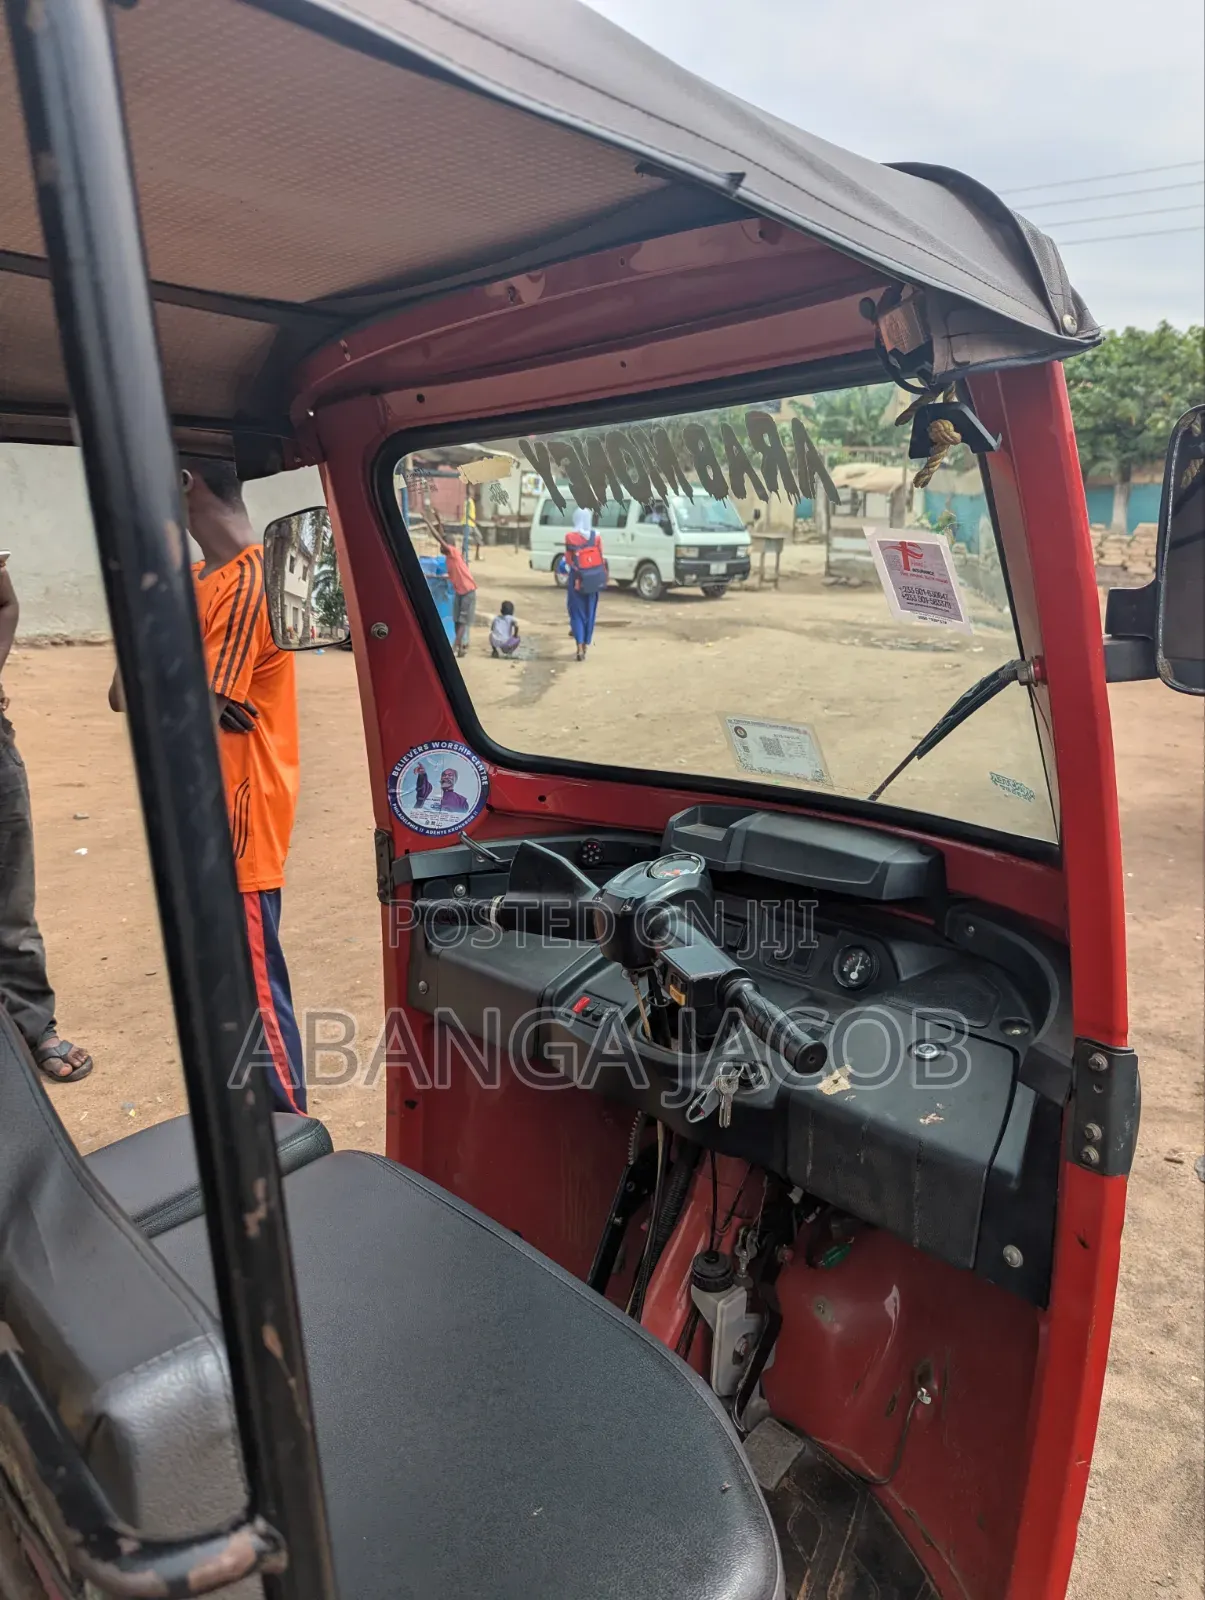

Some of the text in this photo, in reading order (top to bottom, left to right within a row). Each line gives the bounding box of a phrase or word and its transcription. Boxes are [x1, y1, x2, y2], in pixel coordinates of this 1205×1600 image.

[391, 741, 489, 786] BELIEVERS WORSHIP CENTRE
